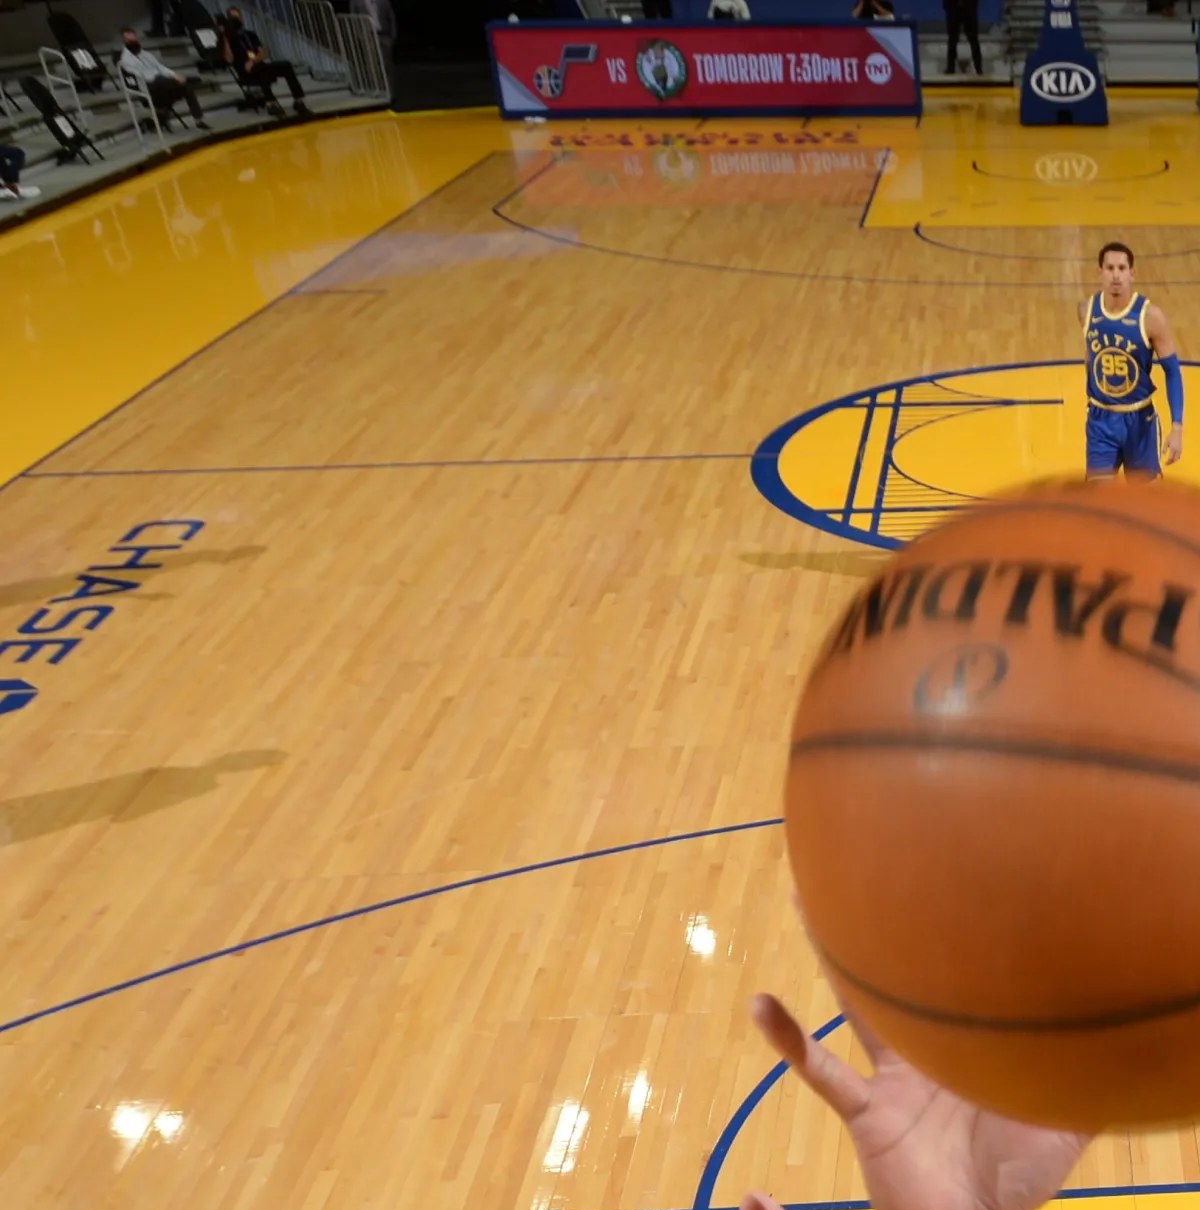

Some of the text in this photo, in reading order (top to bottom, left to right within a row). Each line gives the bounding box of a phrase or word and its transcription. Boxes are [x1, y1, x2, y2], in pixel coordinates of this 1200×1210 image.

[606, 58, 628, 83] VS
[693, 53, 783, 83] TOMORROW
[844, 57, 859, 83] ET
[1041, 70, 1085, 94] KIA
[1091, 333, 1137, 353] CITY
[1101, 354, 1129, 376] 95
[0, 520, 206, 665] CHASE
